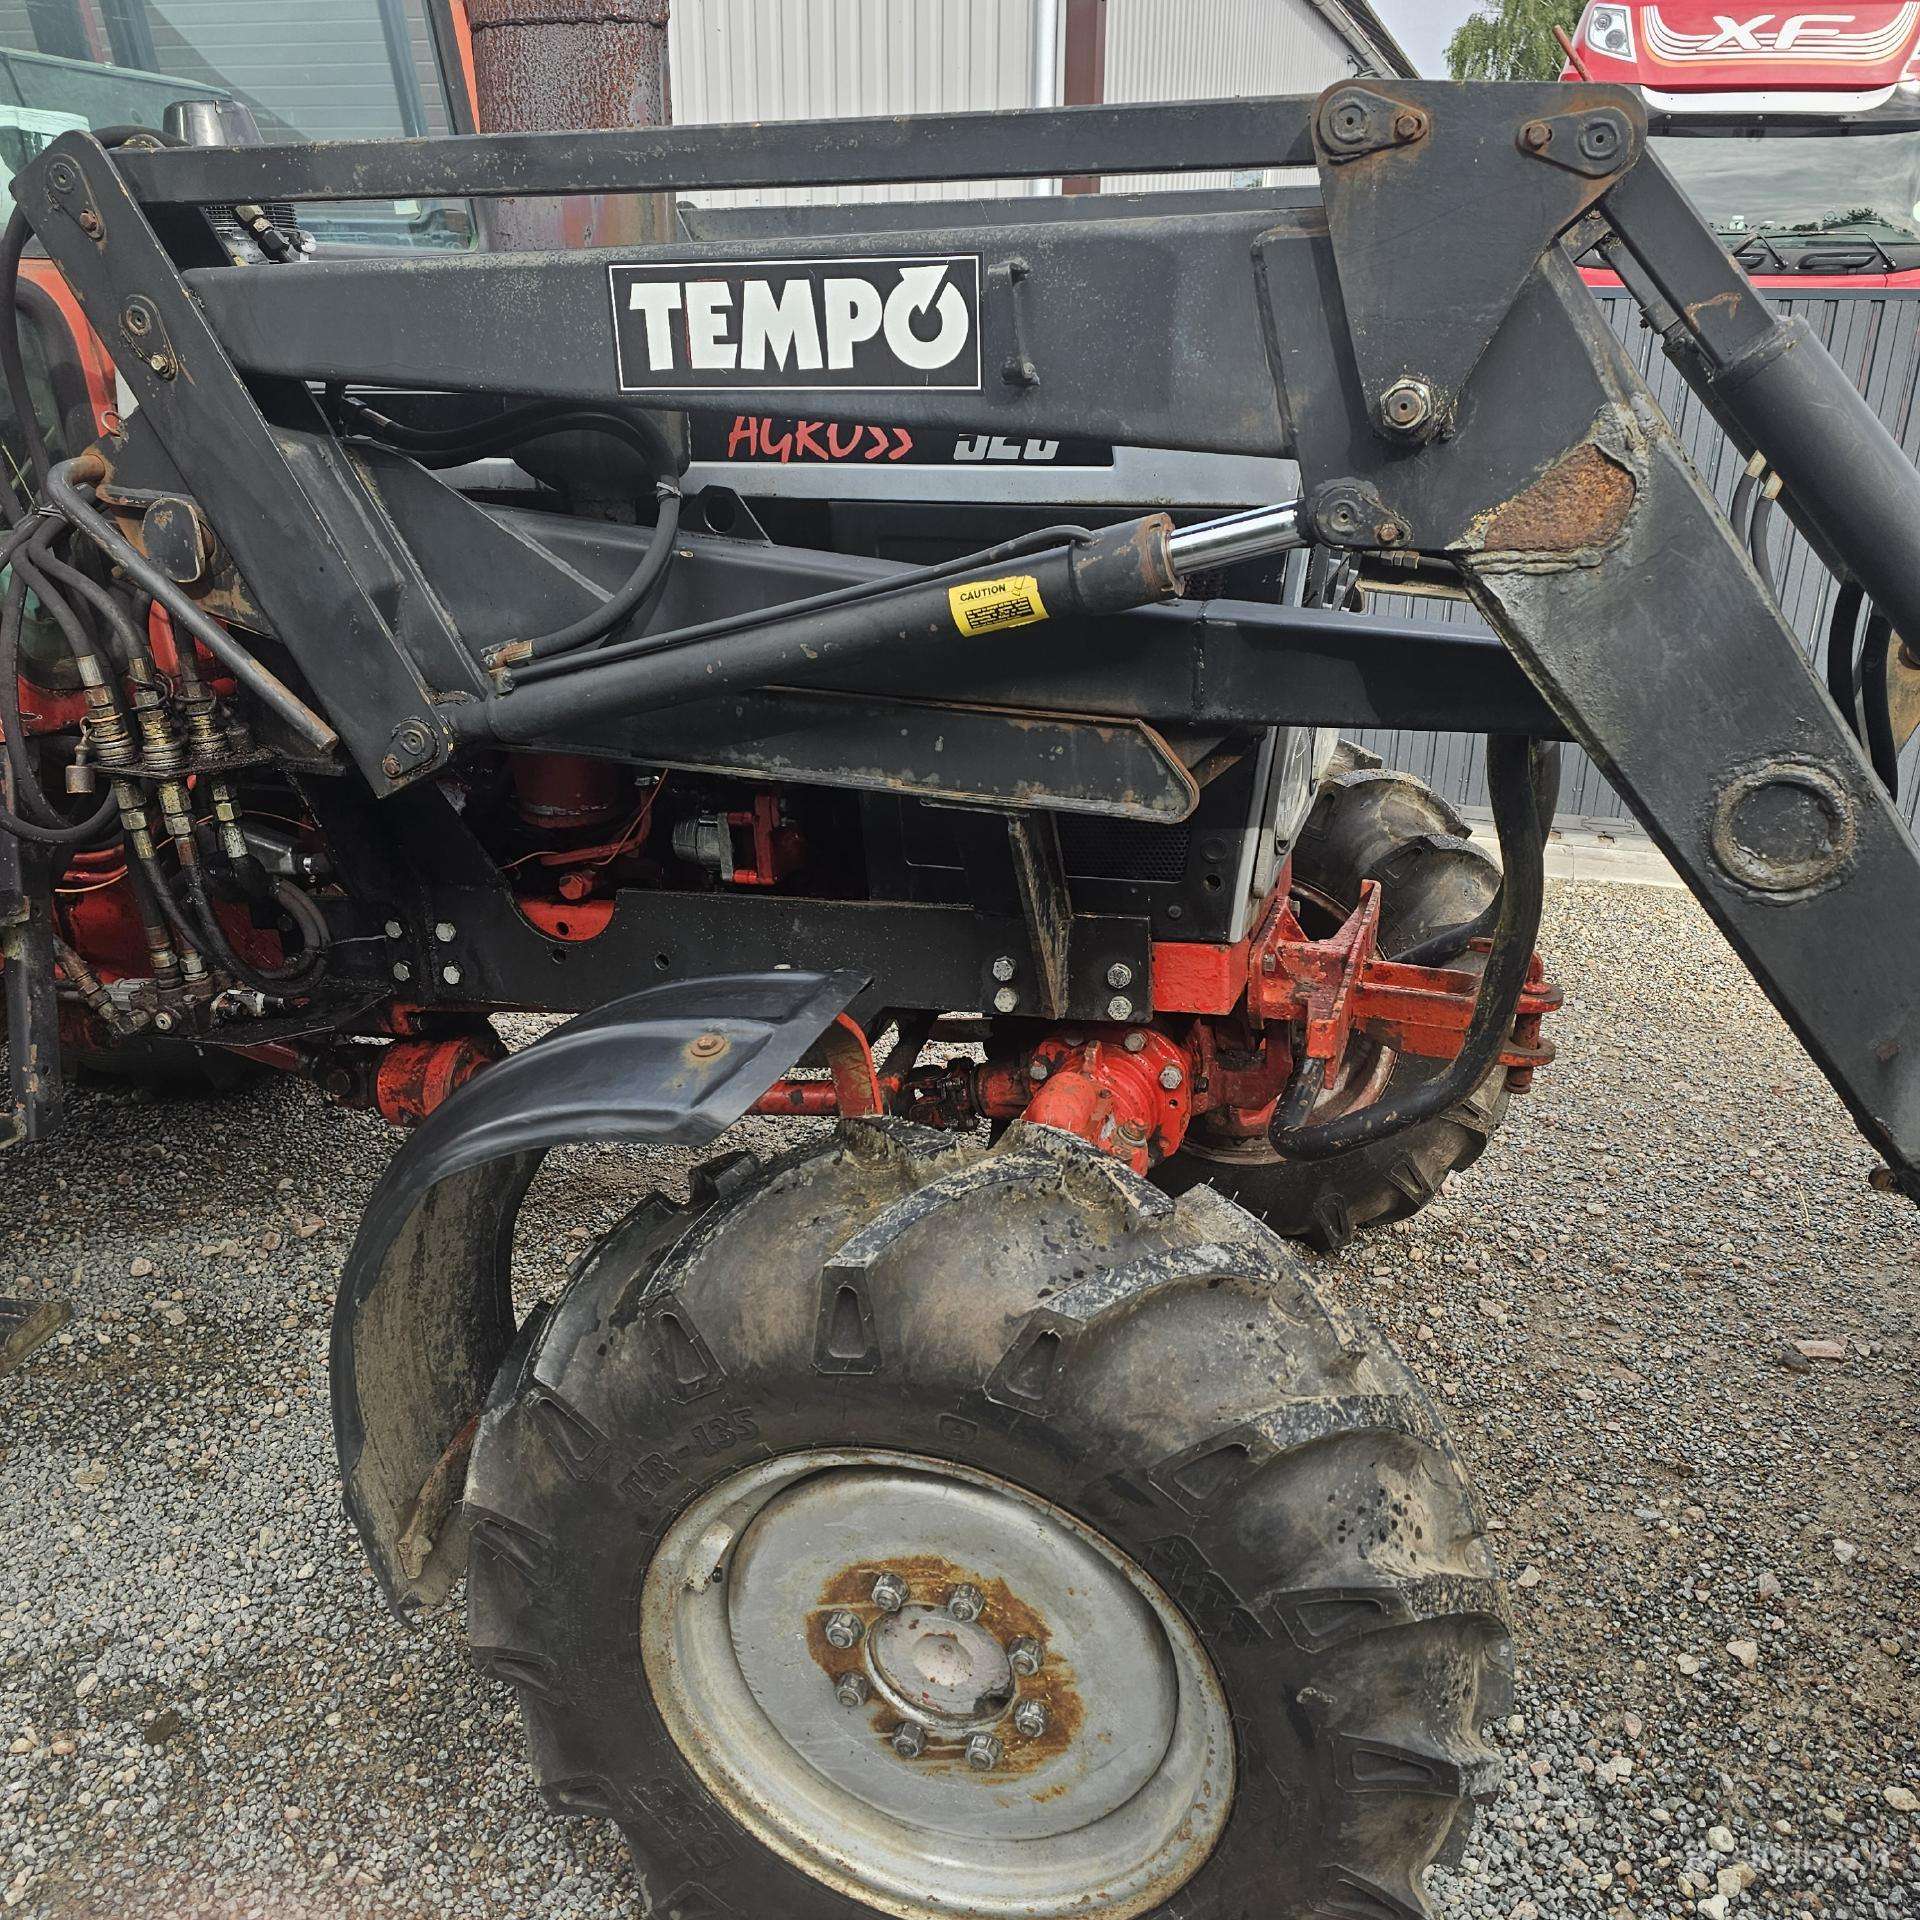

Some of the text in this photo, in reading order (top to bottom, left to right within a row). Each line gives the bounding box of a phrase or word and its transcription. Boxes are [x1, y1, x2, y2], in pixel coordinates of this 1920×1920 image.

[1696, 14, 1856, 52] XF
[629, 264, 970, 372] TEMPO
[960, 583, 1006, 602] CAUTION
